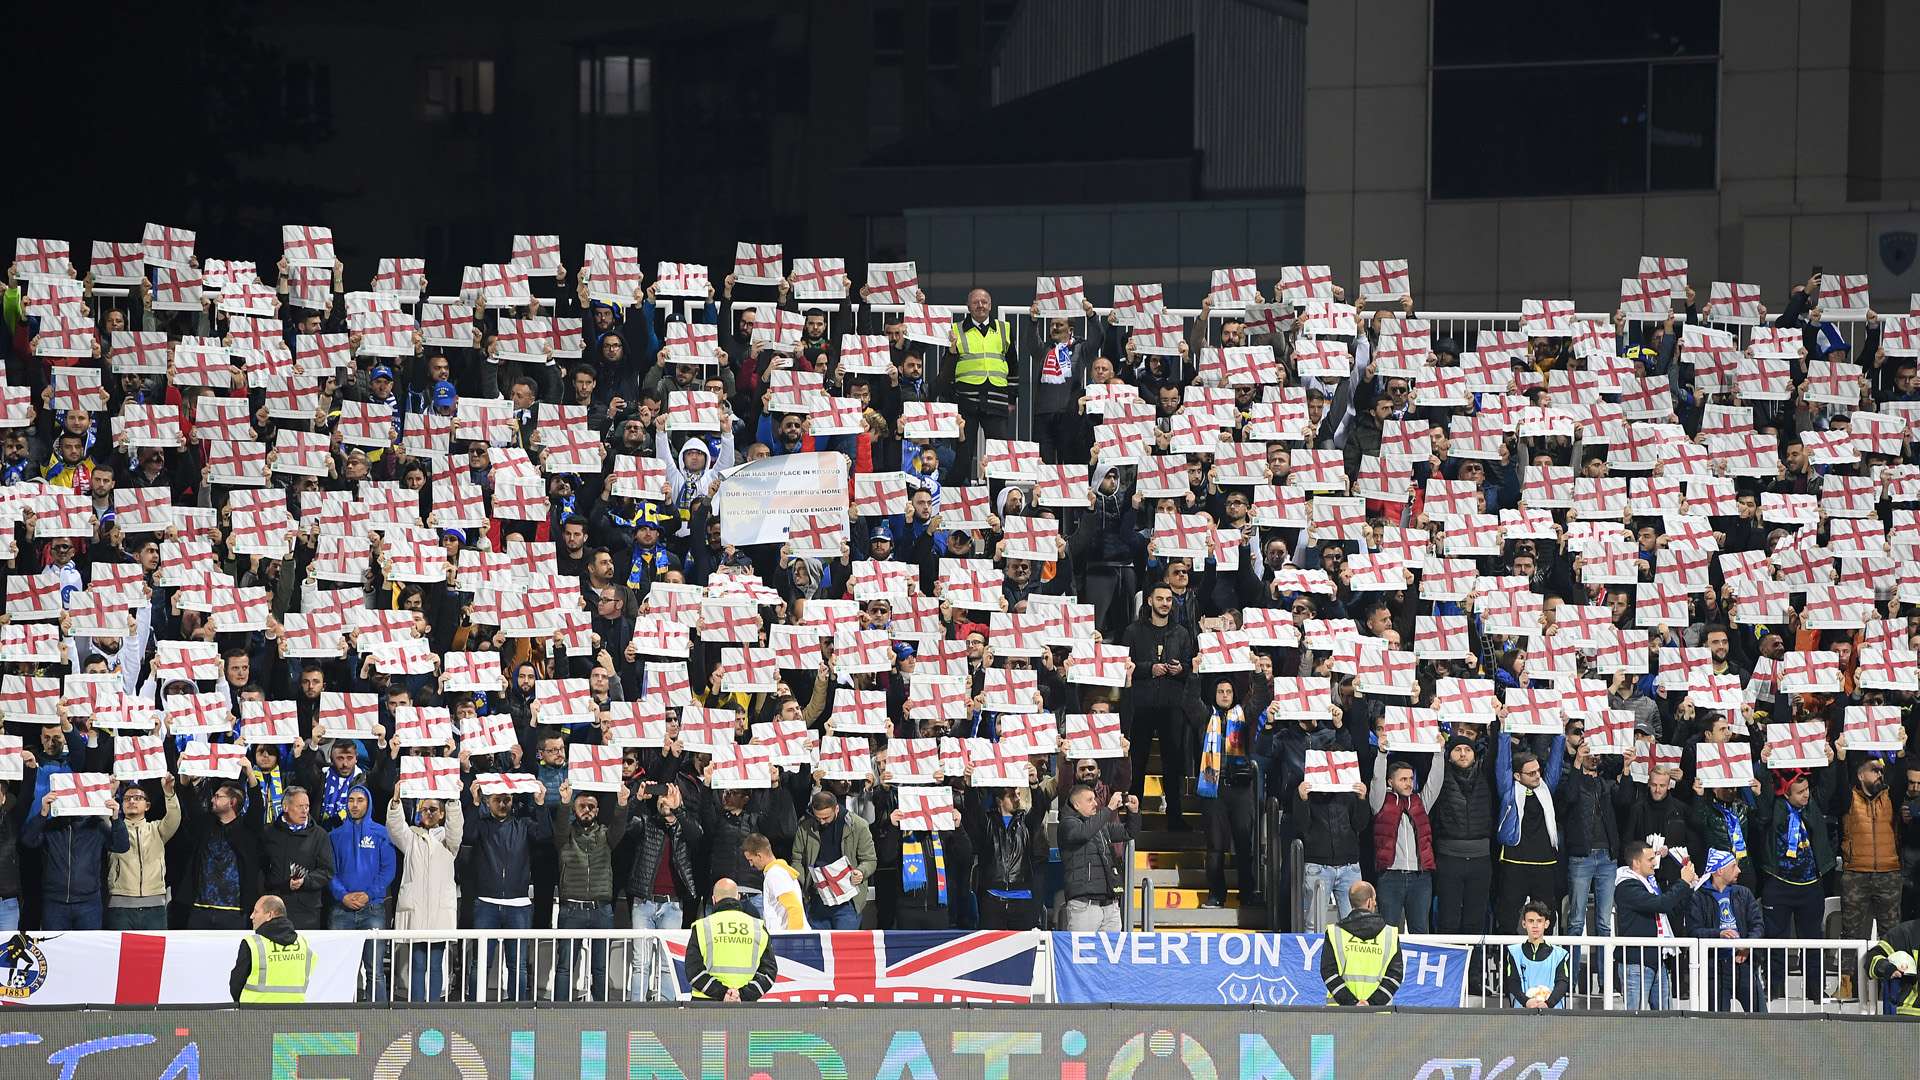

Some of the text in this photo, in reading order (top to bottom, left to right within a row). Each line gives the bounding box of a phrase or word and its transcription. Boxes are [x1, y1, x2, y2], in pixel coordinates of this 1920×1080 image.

[777, 507, 809, 515] BELOVED
[810, 505, 843, 513] ENGLAND
[1166, 891, 1182, 909] D
[716, 921, 750, 936] 158
[713, 936, 753, 945] STEWARD
[1344, 944, 1384, 955] STEWARD
[267, 953, 306, 963] STEWARD
[1071, 931, 1449, 988] EVERTON YTH
[4, 987, 25, 997] 1883
